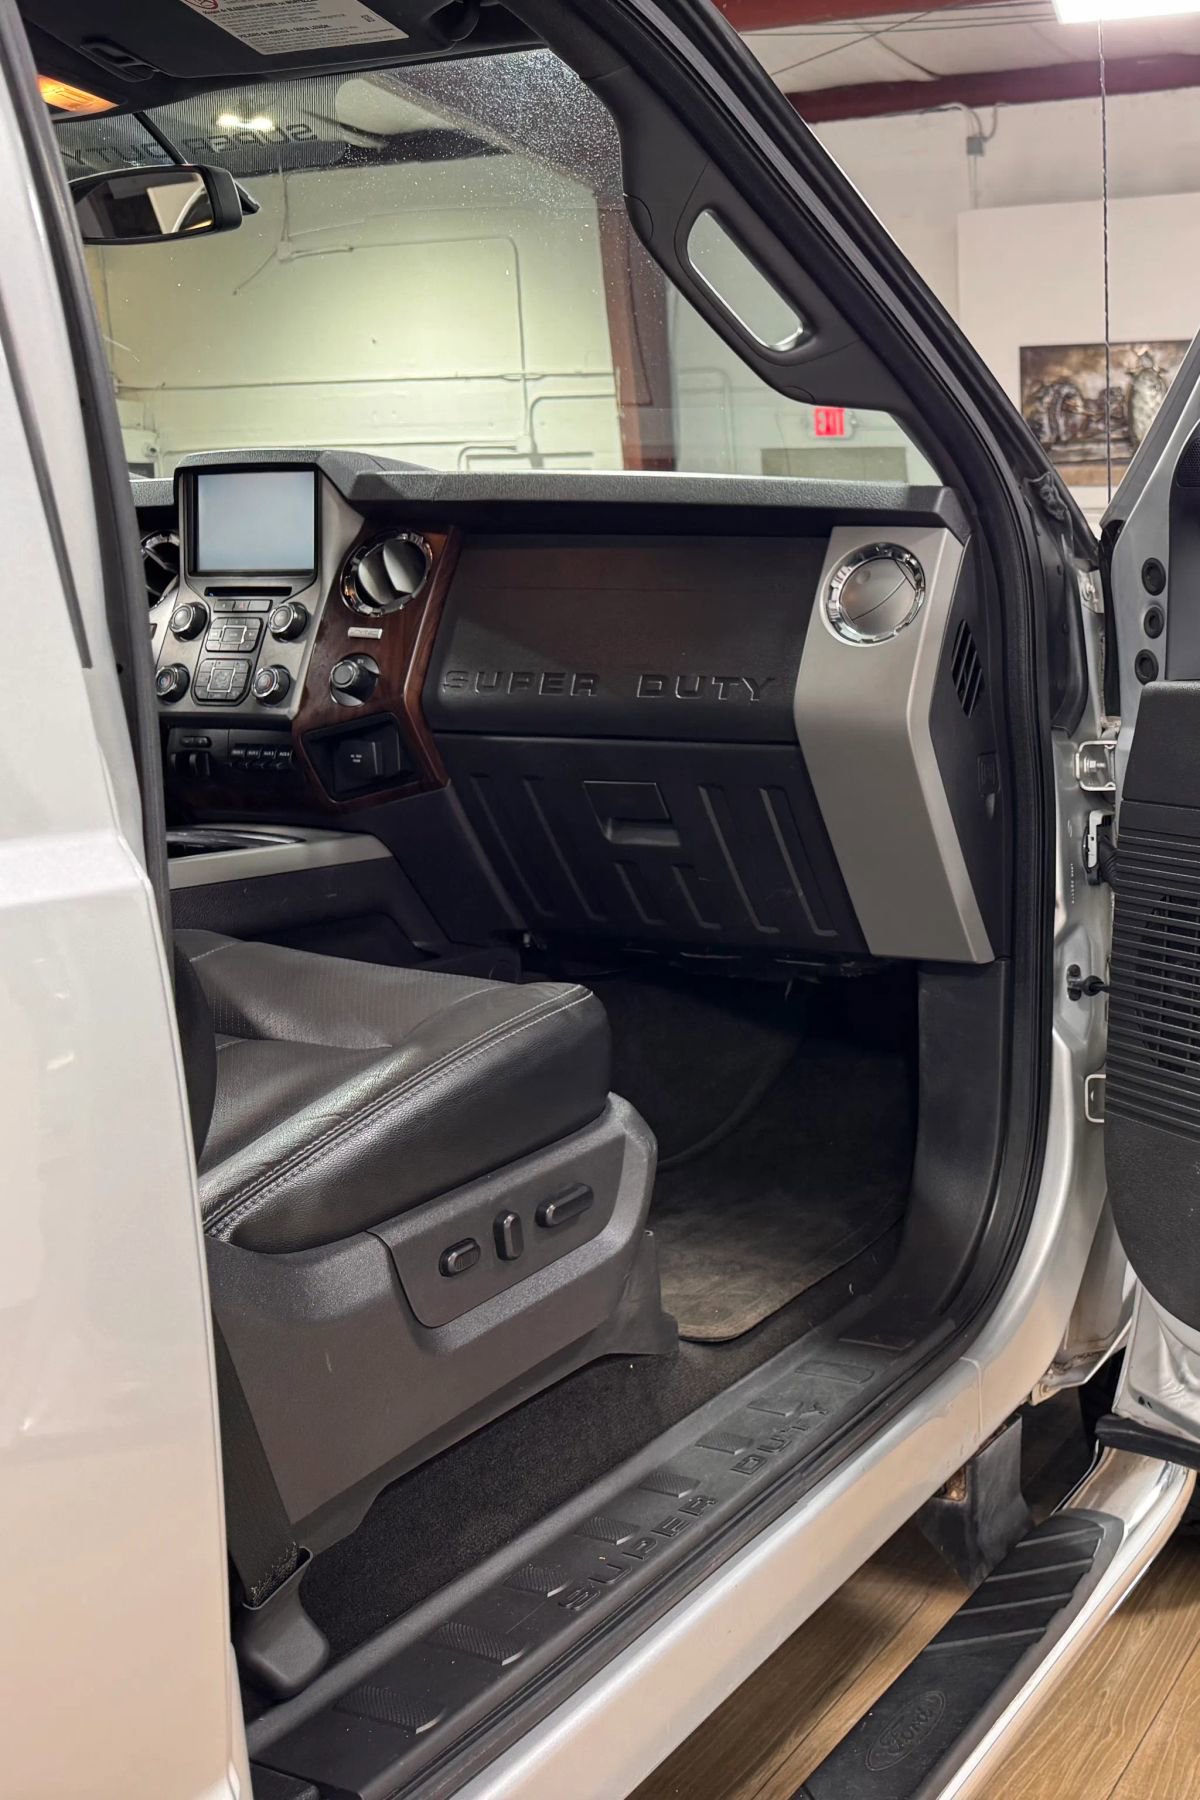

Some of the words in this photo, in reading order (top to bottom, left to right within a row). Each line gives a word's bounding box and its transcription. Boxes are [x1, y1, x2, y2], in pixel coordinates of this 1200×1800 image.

[441, 670, 600, 698] SUPER
[636, 673, 776, 702] DUTY
[557, 1494, 717, 1612] SUPER
[730, 1401, 830, 1476] DUTY
